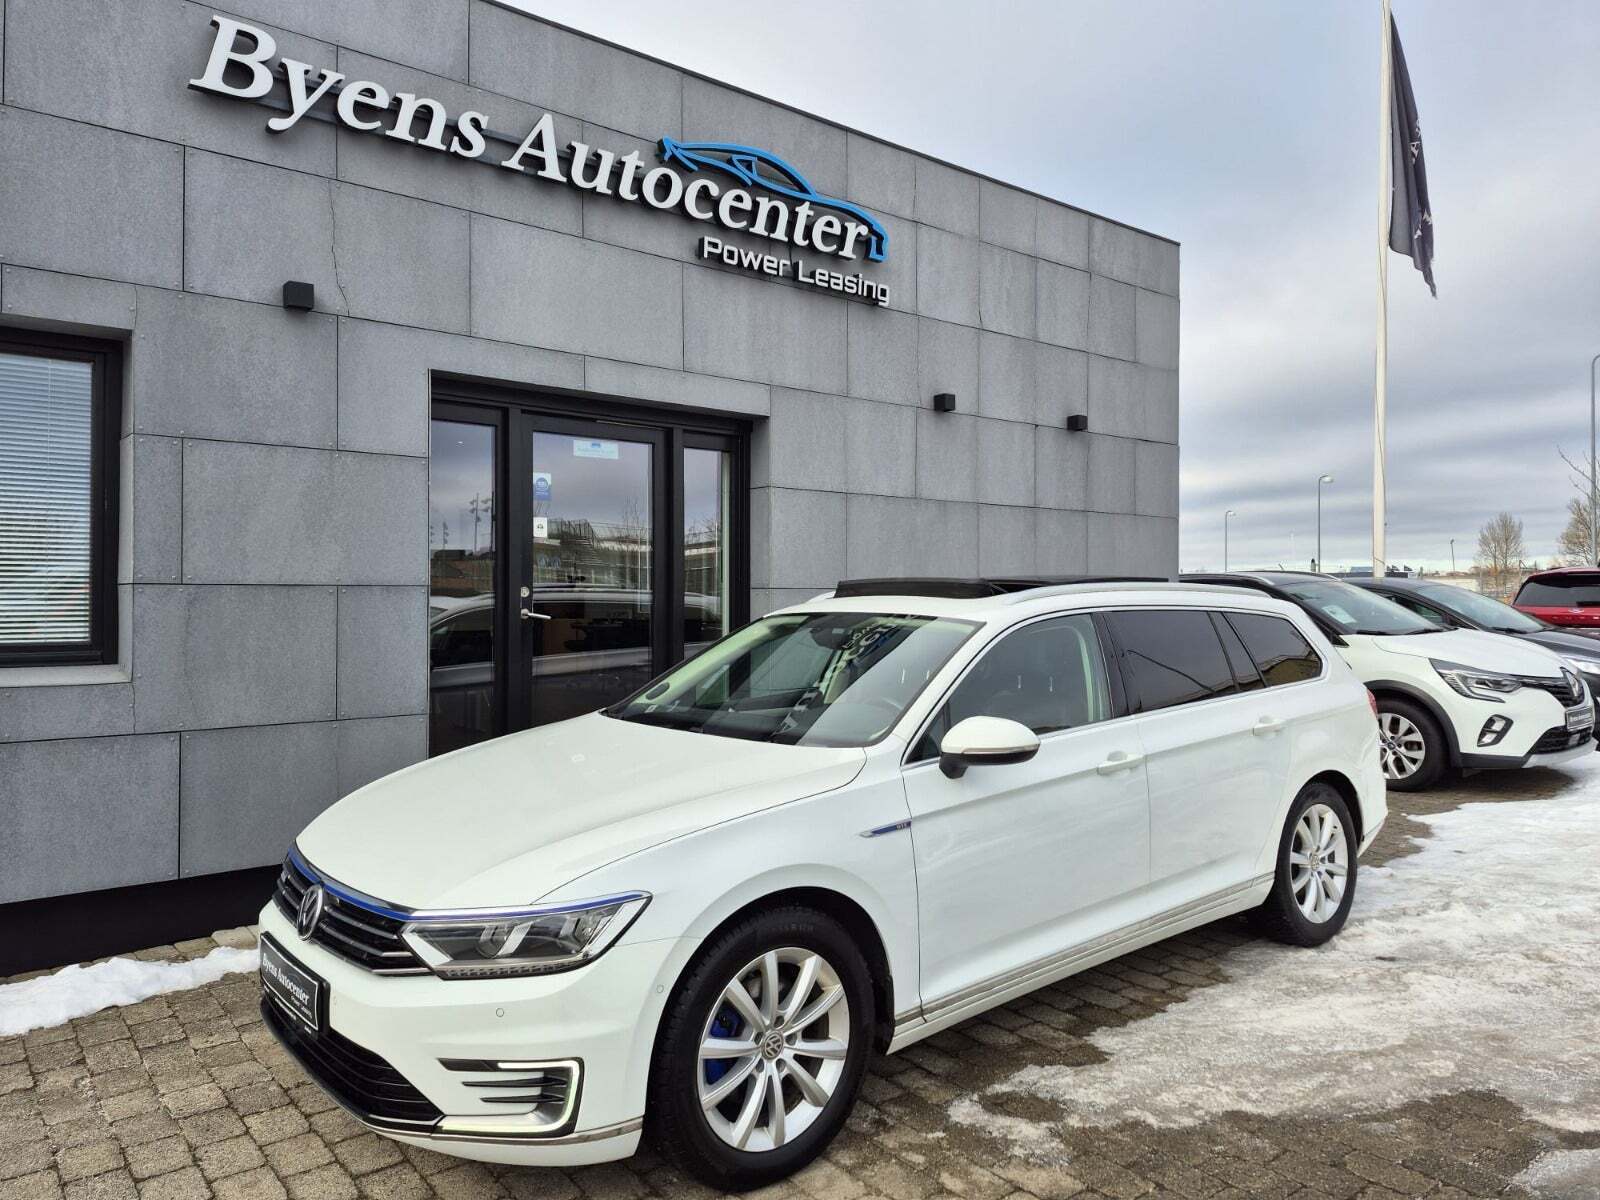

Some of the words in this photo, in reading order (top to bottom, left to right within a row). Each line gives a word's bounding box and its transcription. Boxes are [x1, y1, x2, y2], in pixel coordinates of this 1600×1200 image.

[187, 15, 489, 158] Byens
[501, 113, 869, 260] Autocenter
[702, 236, 791, 277] Power
[798, 260, 890, 307] Leasing
[277, 967, 310, 1006] Autocenter
